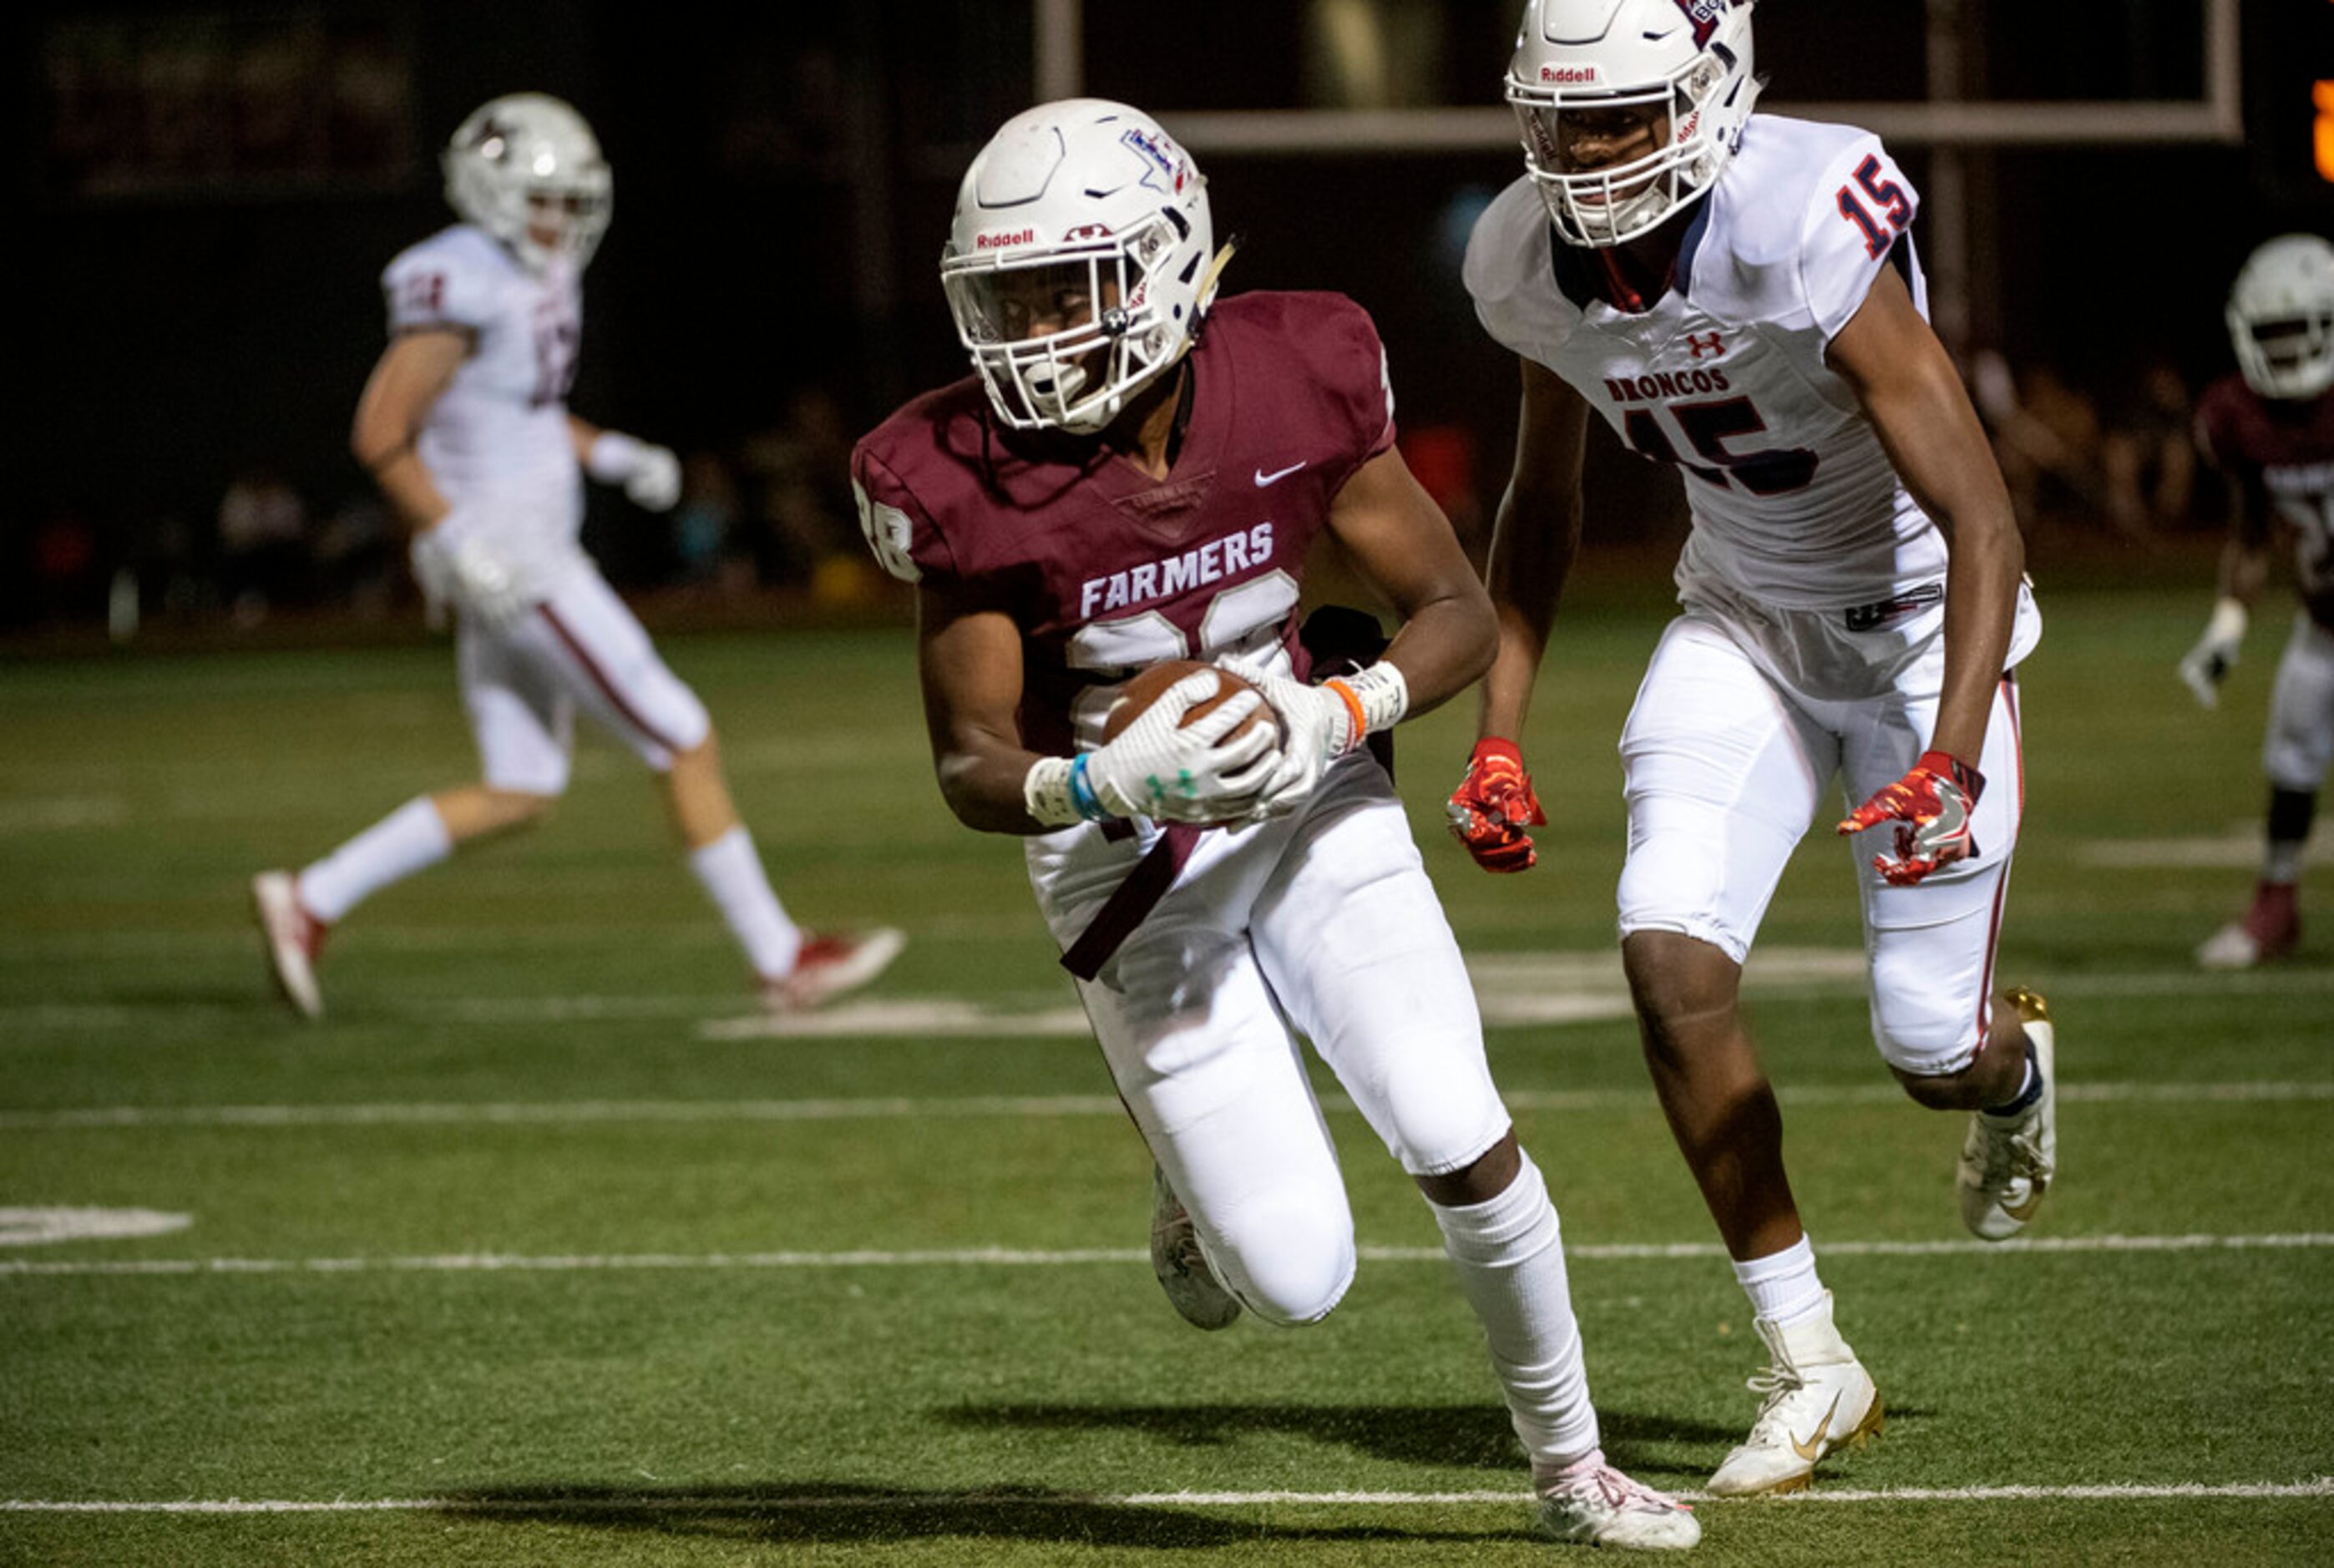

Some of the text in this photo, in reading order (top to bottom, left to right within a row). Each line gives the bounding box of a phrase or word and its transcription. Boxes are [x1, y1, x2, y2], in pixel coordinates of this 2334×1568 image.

[1541, 68, 1595, 82] Riddell
[977, 229, 1033, 249] Riddell
[1835, 154, 1911, 261] 15
[1603, 368, 1730, 402] BRONCOS
[1623, 395, 1820, 496] 15
[1080, 522, 1273, 619] FARMERS
